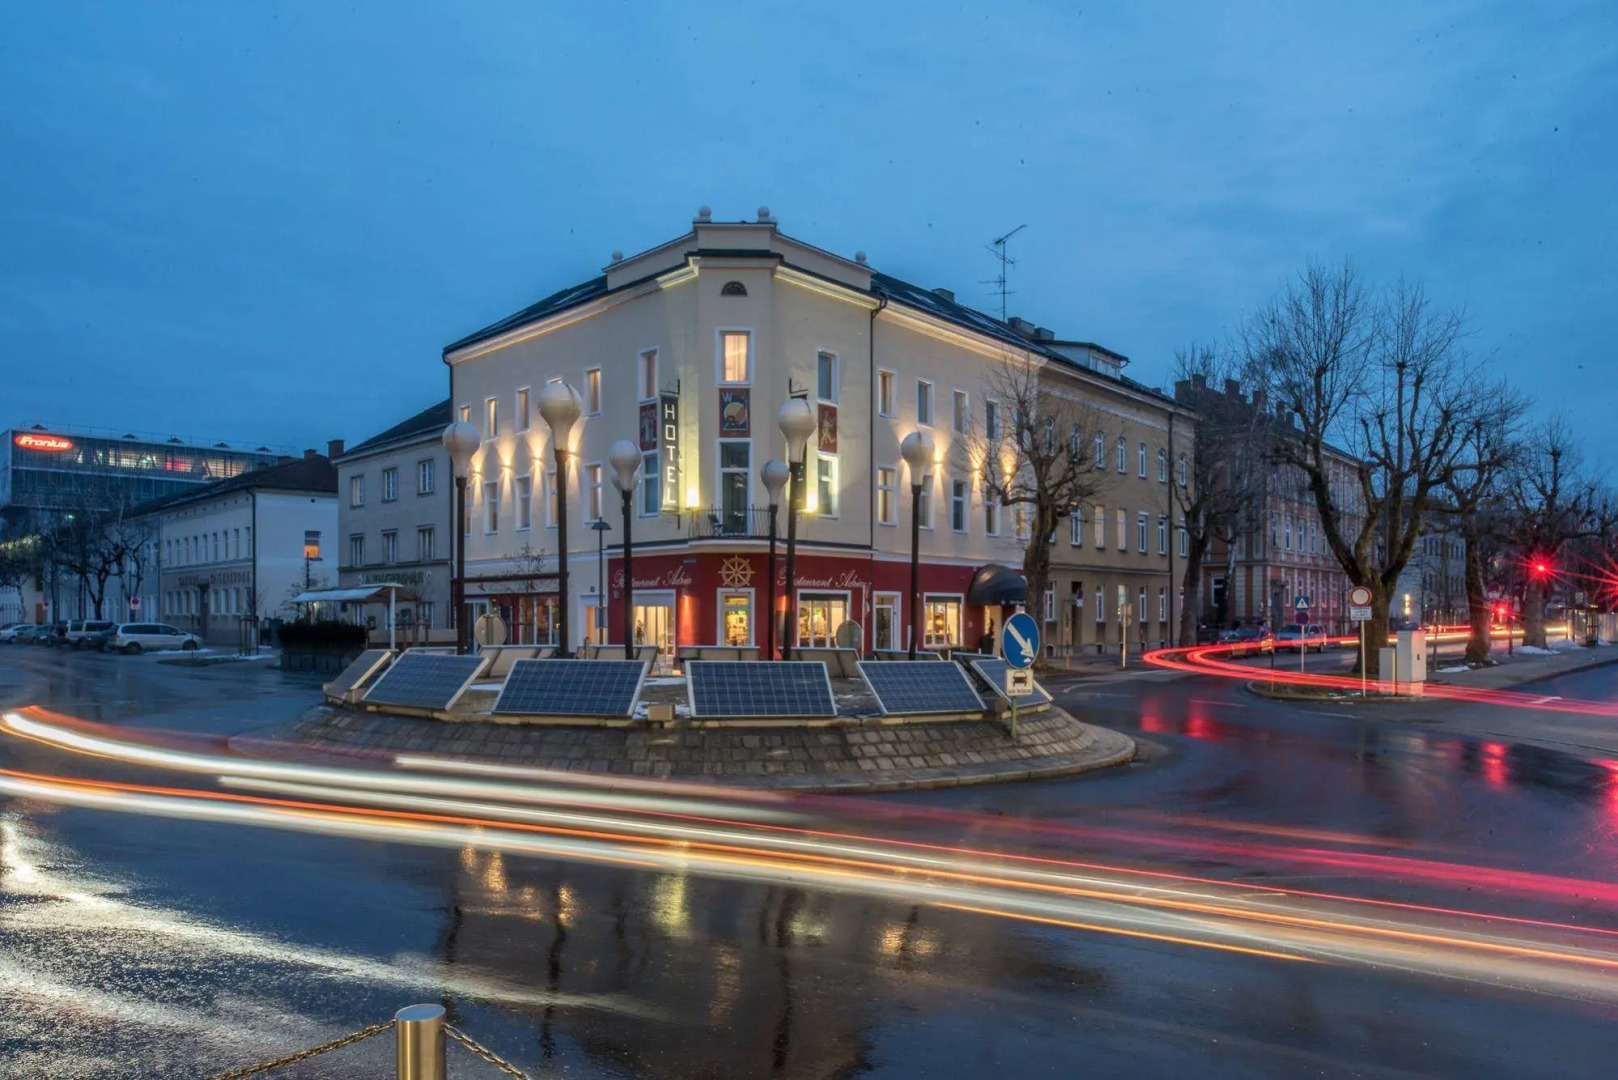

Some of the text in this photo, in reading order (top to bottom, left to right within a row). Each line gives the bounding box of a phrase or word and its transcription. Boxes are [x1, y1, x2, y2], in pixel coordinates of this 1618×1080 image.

[665, 404, 678, 504] HOTEL
[612, 565, 692, 589] Rtaurant Adria
[777, 565, 833, 588] Rstaurant
